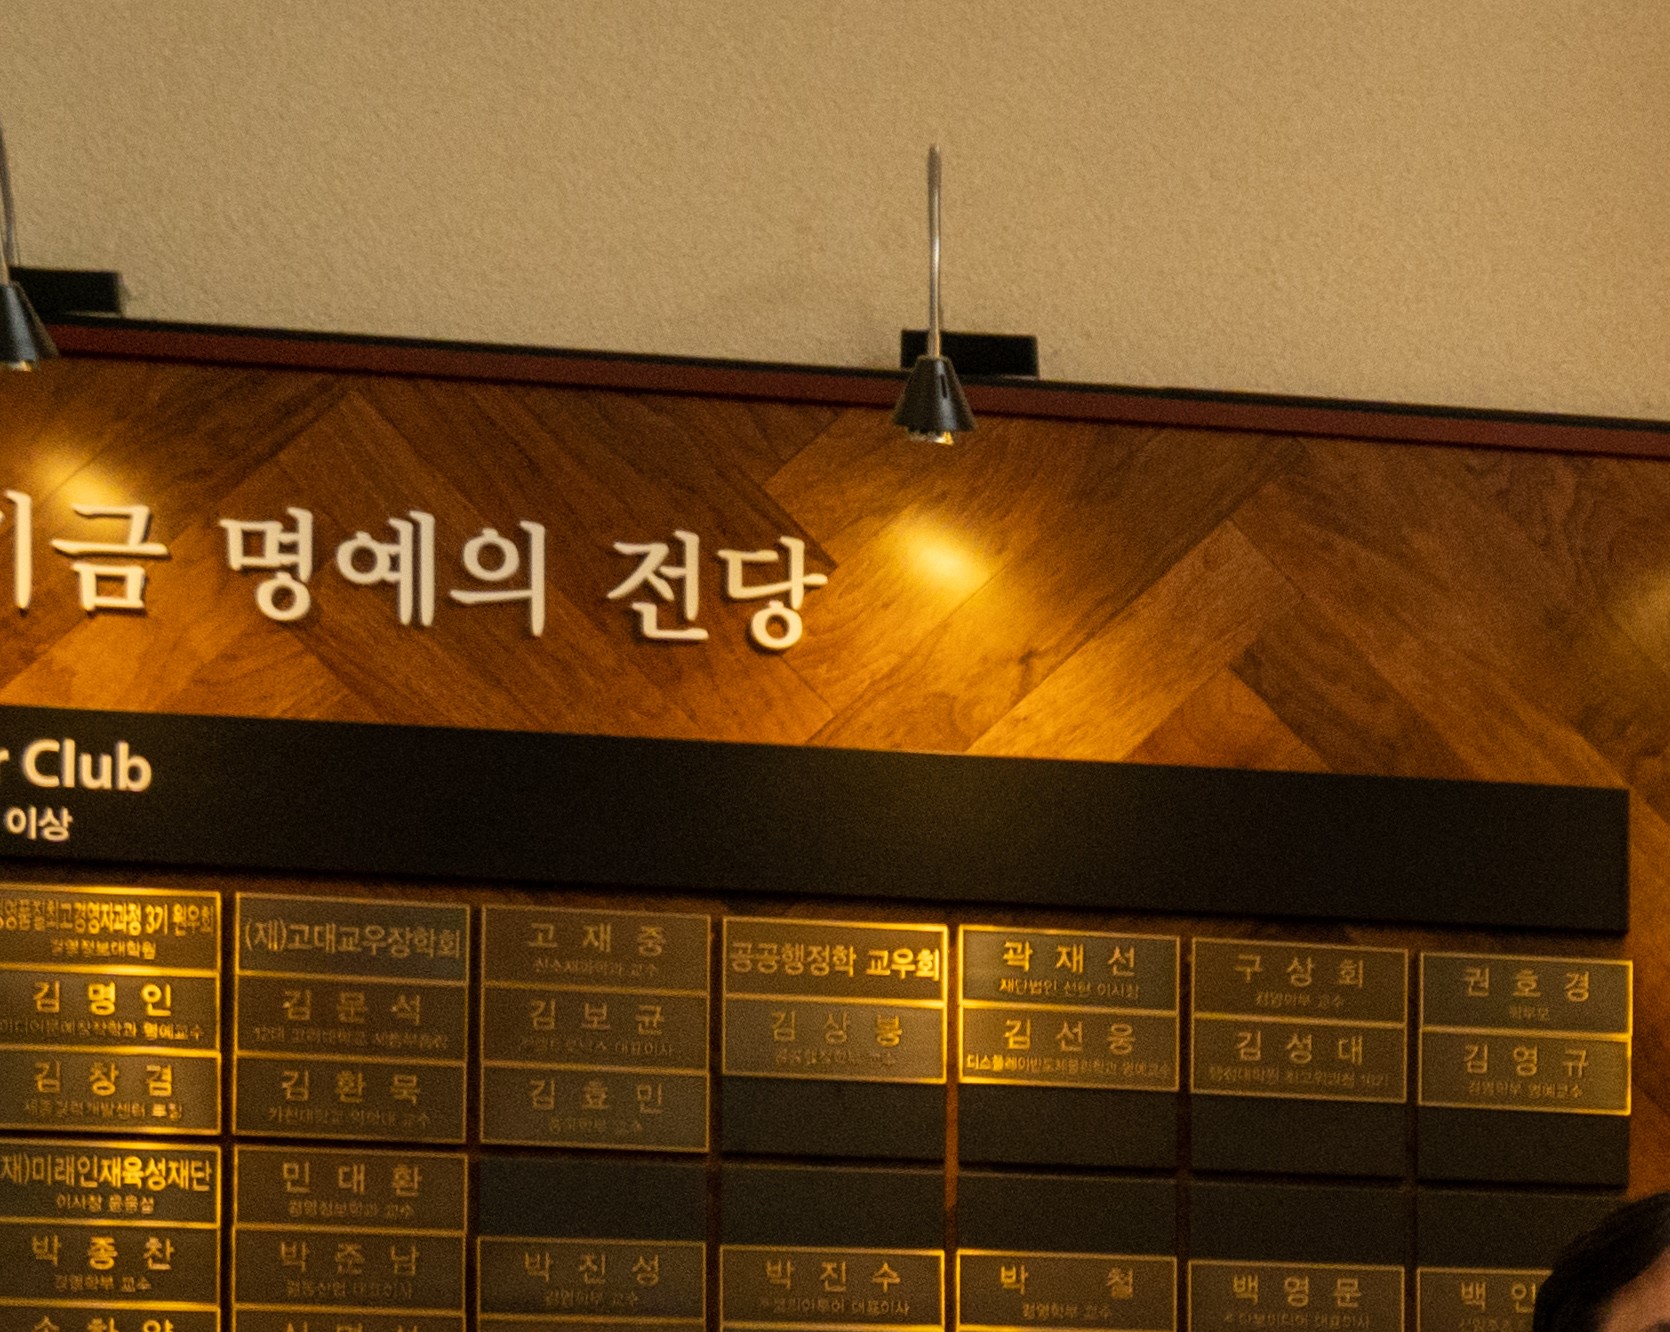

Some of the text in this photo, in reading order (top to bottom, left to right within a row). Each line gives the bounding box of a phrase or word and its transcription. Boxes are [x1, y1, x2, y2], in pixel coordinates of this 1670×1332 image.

[220, 507, 546, 638] 명예의
[607, 529, 828, 652] 전당
[23, 739, 153, 792] Club
[6, 808, 73, 843] 이상
[730, 941, 941, 981] 공공행정학 교우회
